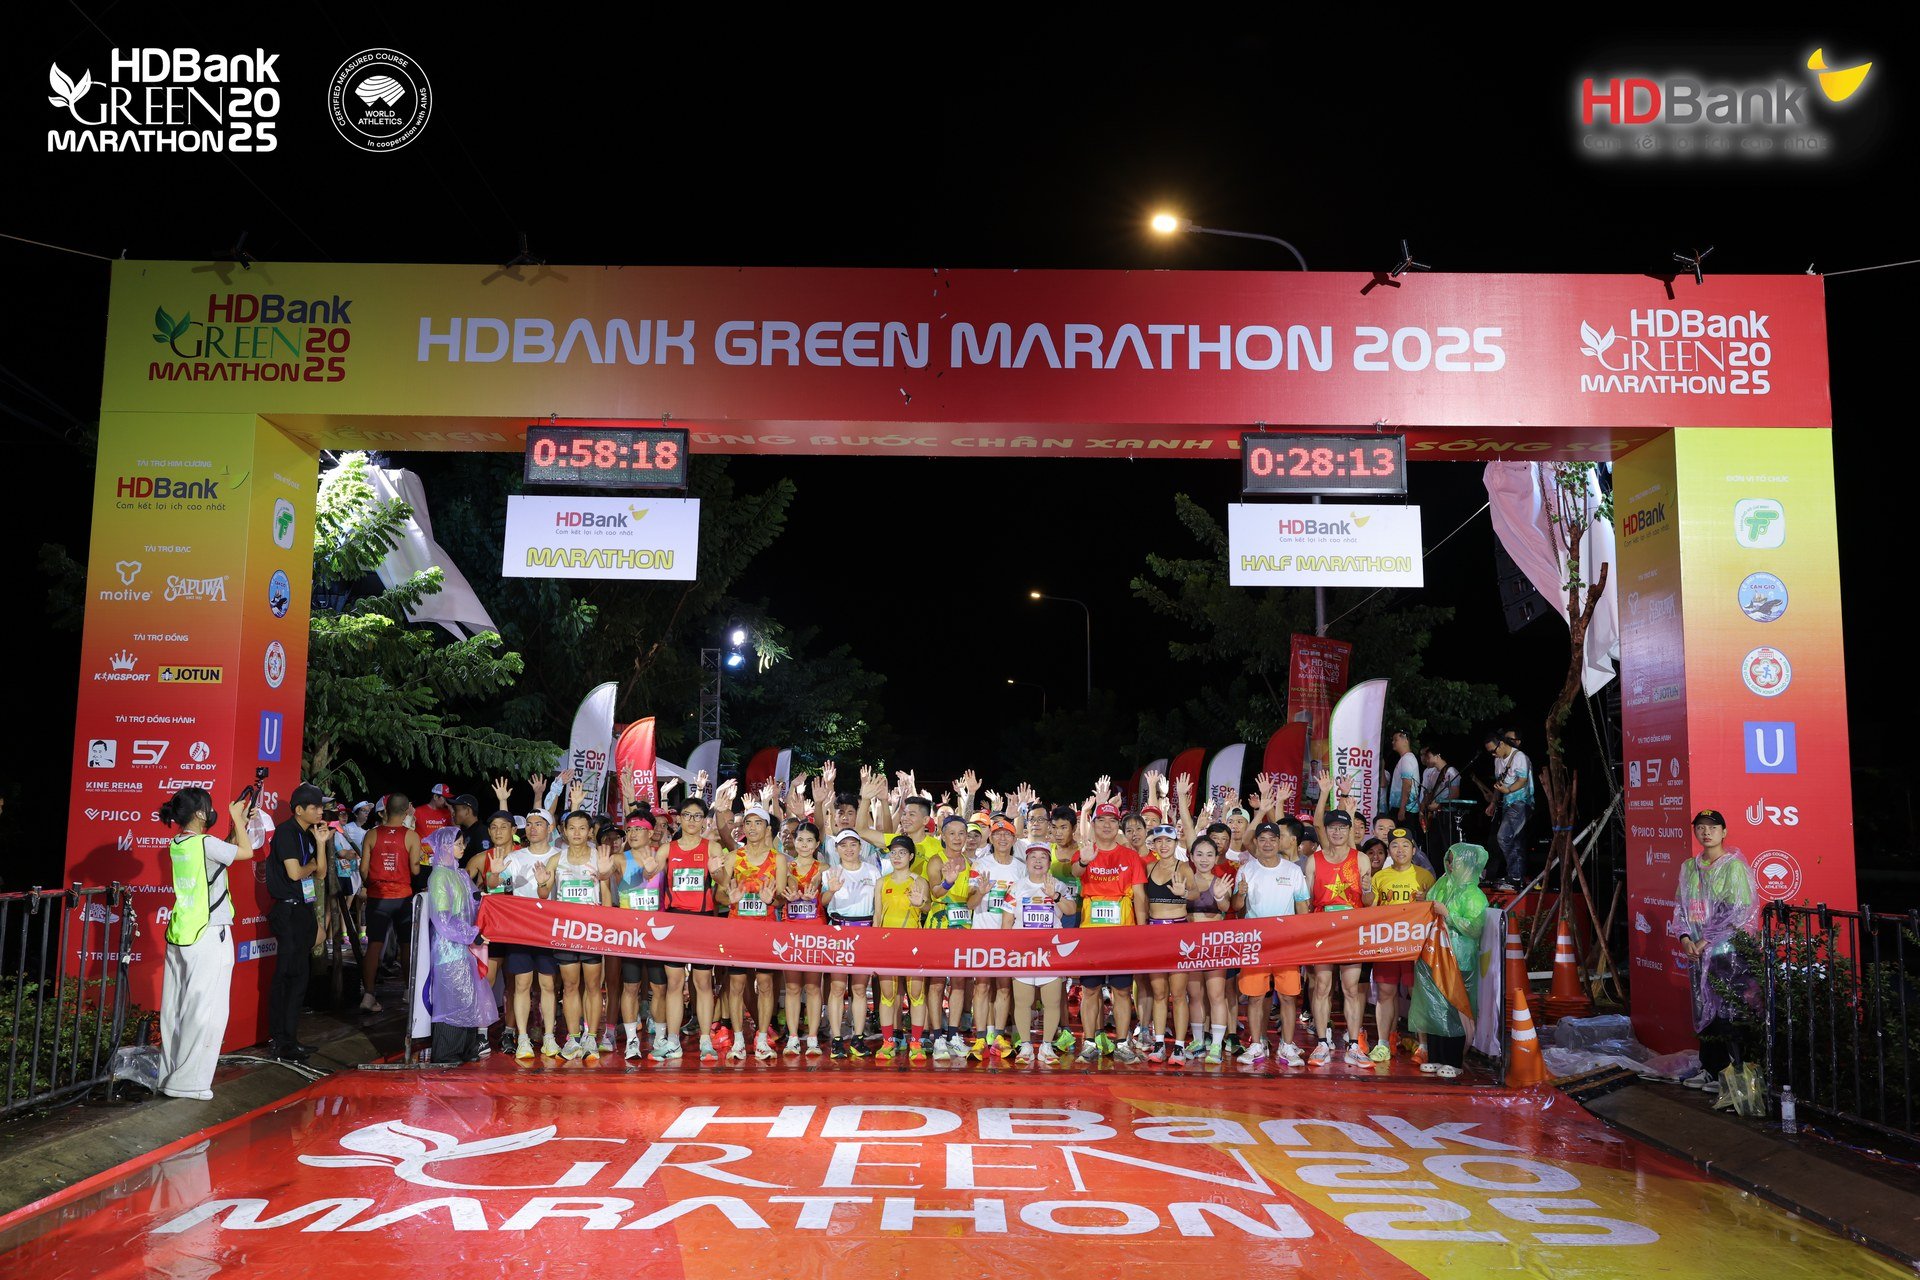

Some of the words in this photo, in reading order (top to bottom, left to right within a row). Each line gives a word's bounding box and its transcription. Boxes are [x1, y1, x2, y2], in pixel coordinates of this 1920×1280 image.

[208, 294, 352, 325] HDBank
[1630, 308, 1770, 339] HDBank
[171, 321, 302, 359] GREEN
[306, 327, 350, 354] 20
[418, 317, 695, 365] HDBANK
[714, 320, 929, 368] GREEN
[951, 322, 1333, 371] MARATHON
[1353, 326, 1506, 372] 2025
[1601, 337, 1727, 373] GREEN
[1728, 341, 1771, 368] 20
[148, 362, 300, 382] MARATHON
[303, 356, 346, 382] 25
[1581, 374, 1726, 395] MARATHON
[1729, 369, 1771, 395] 25
[951, 433, 1073, 449] CHÂN
[1085, 438, 1213, 450] XANH
[1409, 436, 1549, 452] SỐNG
[533, 438, 678, 470] 0:58:18
[1250, 447, 1395, 477] 0:28:13
[116, 476, 219, 500] HDBank
[116, 501, 134, 509] Cam
[187, 503, 202, 511] cao
[556, 511, 628, 528] HDBank
[1279, 519, 1351, 535] HDBank
[1623, 502, 1665, 537] HDBank
[555, 528, 569, 536] Cam
[526, 547, 674, 569] MARATHON
[1241, 555, 1292, 571] HALF
[1296, 555, 1412, 572] MARATHON
[100, 589, 151, 601] motive
[164, 575, 227, 602] SAPUWA
[174, 668, 220, 681] JOTUN
[115, 715, 127, 723] TÀI
[129, 715, 145, 724] TRỢ
[147, 714, 170, 724] ĐỒNG
[172, 716, 195, 724] HÀNH
[264, 717, 278, 755] U
[1349, 747, 1361, 767] 20
[1756, 728, 1785, 767] U
[585, 750, 596, 770] 20
[1361, 749, 1373, 768] 25
[633, 769, 644, 785] 20
[643, 769, 653, 784] 25
[101, 810, 141, 822] PJICO
[1658, 828, 1683, 838] SUUNTO
[1090, 866, 1119, 875] HDBank
[127, 885, 137, 893] ÁC
[157, 884, 175, 893] HÀN
[1027, 913, 1050, 922] 10108
[552, 917, 647, 949] HDBank
[794, 934, 856, 951] HDBank
[1202, 929, 1262, 945] HDBank
[1359, 920, 1438, 946] HDBan
[91, 952, 142, 961] TRUECE
[780, 946, 836, 965] GREEN
[953, 947, 1052, 969] HDBank
[1178, 957, 1240, 969] MARATHON
[1241, 953, 1260, 964] 25
[1187, 944, 1242, 960] GREEN
[1242, 943, 1262, 953] 20
[660, 1105, 1529, 1151] HDBank
[397, 1137, 1279, 1197] GREEN
[1295, 1151, 1582, 1193] 20
[149, 1197, 1315, 1240] MARATHON
[1342, 1193, 1662, 1247] 25
